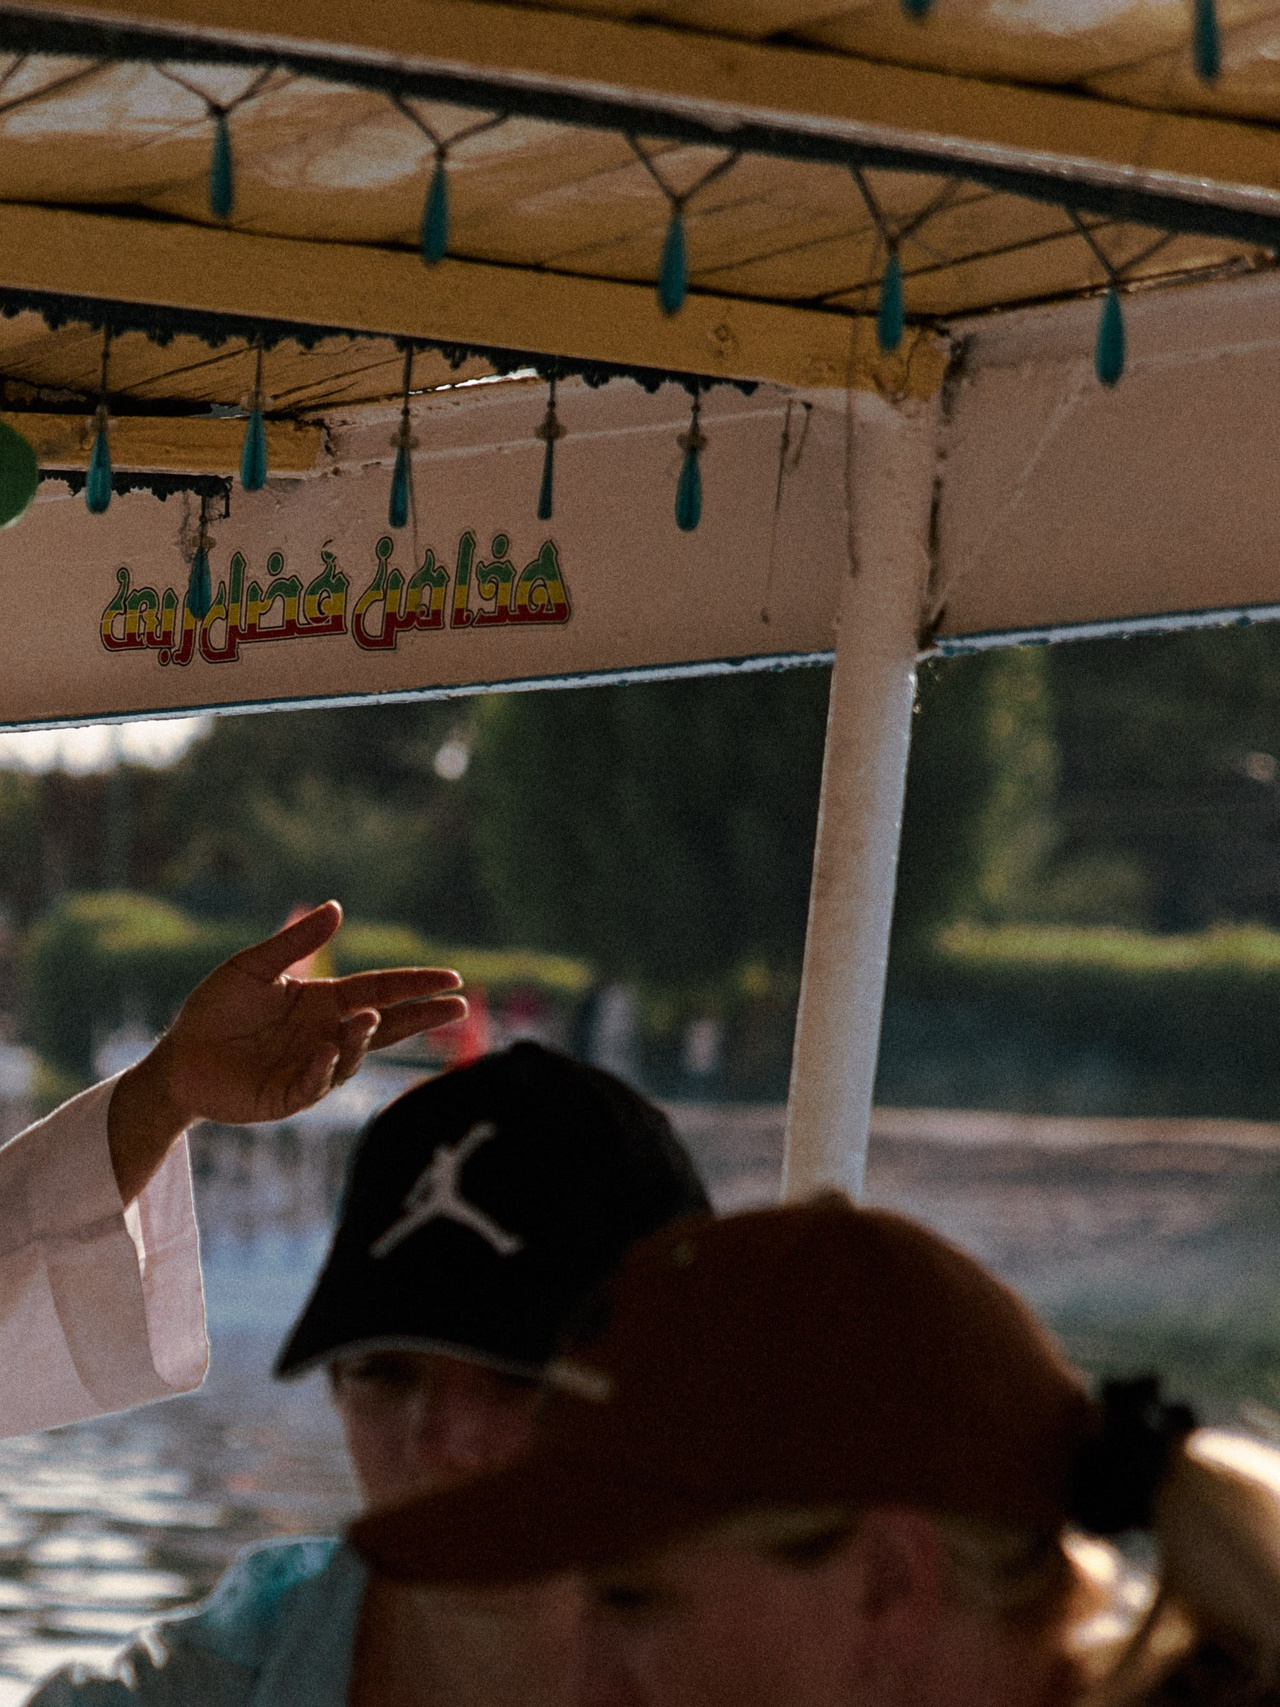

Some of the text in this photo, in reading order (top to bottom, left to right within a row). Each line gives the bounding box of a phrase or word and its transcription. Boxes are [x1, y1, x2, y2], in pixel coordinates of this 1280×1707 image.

[199, 540, 349, 664] فضل
[352, 536, 451, 651] من
[449, 531, 572, 629] هذا
